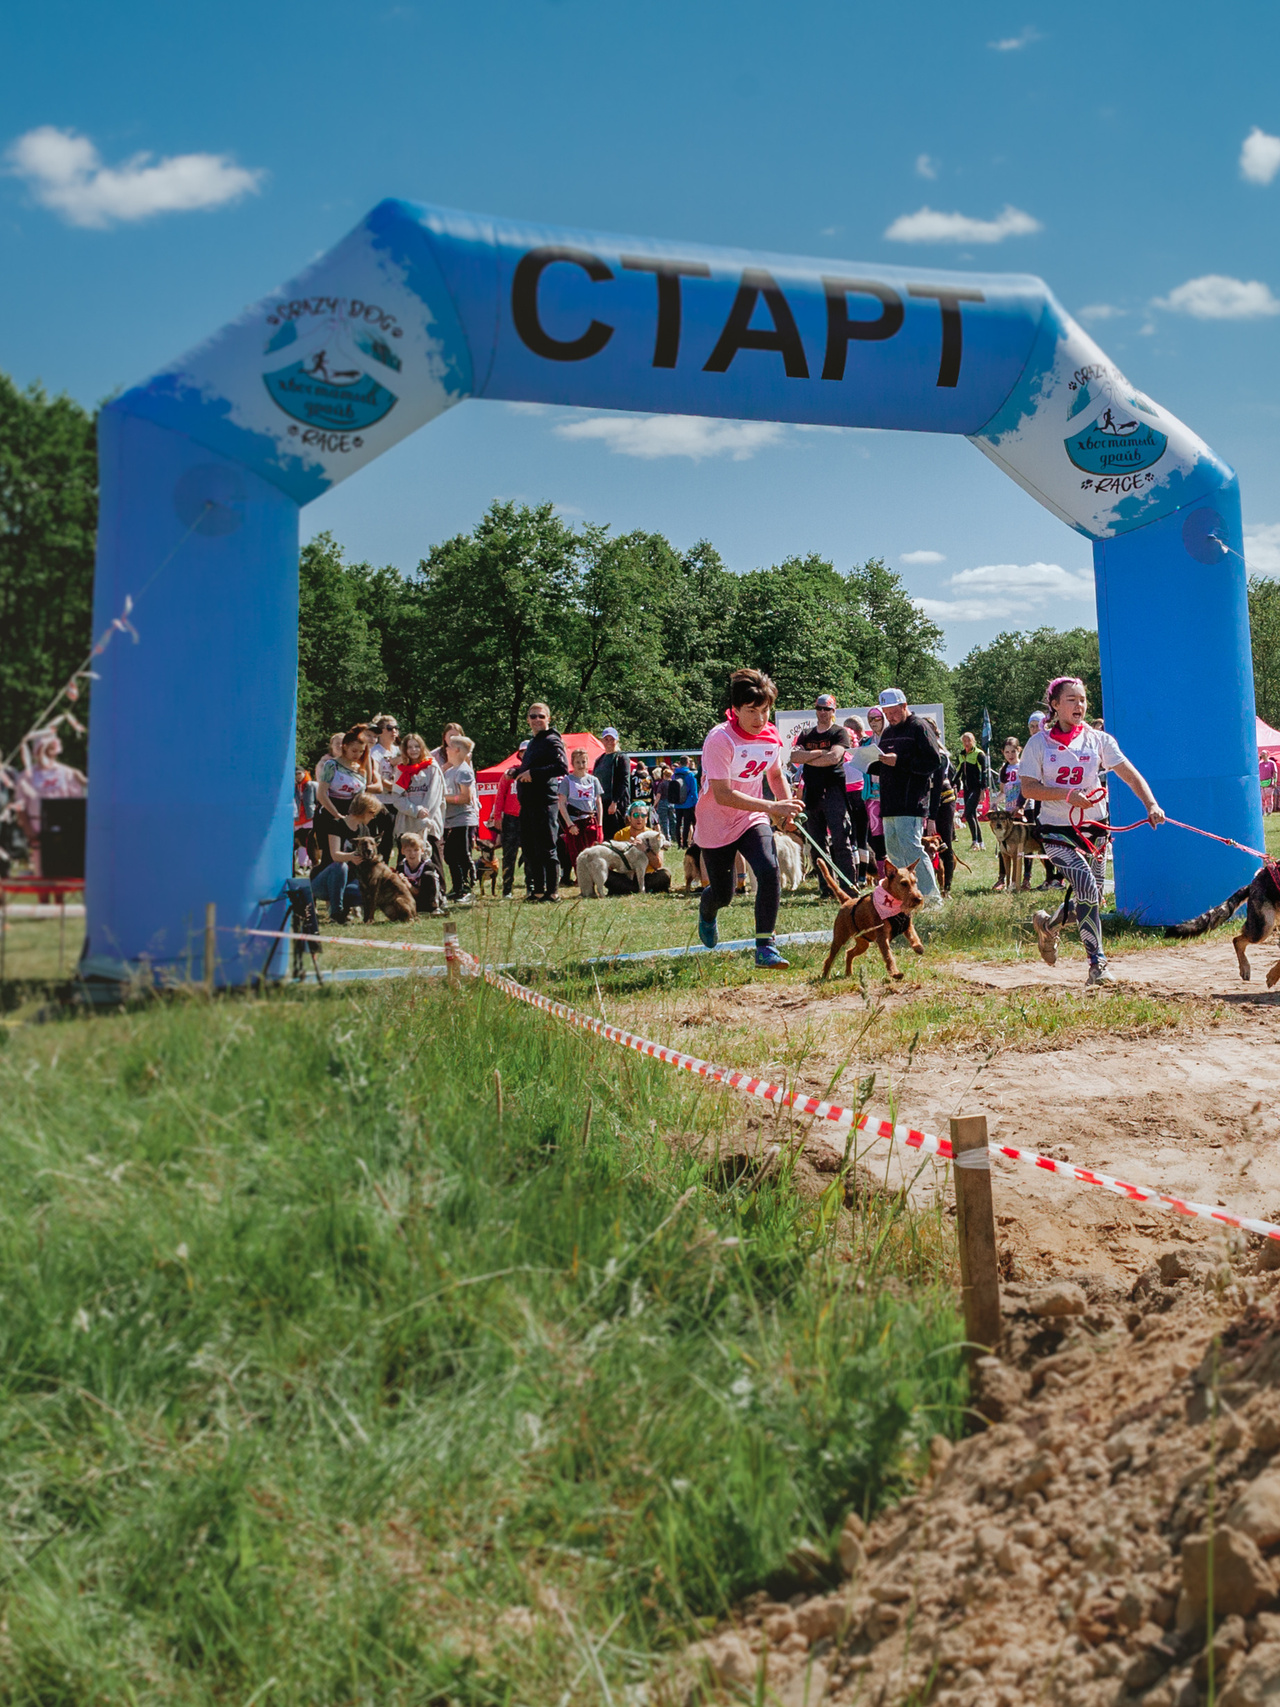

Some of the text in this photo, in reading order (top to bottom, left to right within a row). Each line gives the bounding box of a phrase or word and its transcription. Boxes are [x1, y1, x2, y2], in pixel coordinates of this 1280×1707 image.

[276, 296, 397, 331] CRAZY DOG
[511, 245, 986, 388] СТАРТ
[1074, 364, 1108, 386] CRAZY
[301, 429, 352, 453] RACE
[1077, 434, 1157, 450] хвостатый
[1100, 448, 1146, 470] драйв
[1095, 473, 1145, 494] RACE
[739, 760, 768, 779] 24
[1056, 766, 1084, 785] 23
